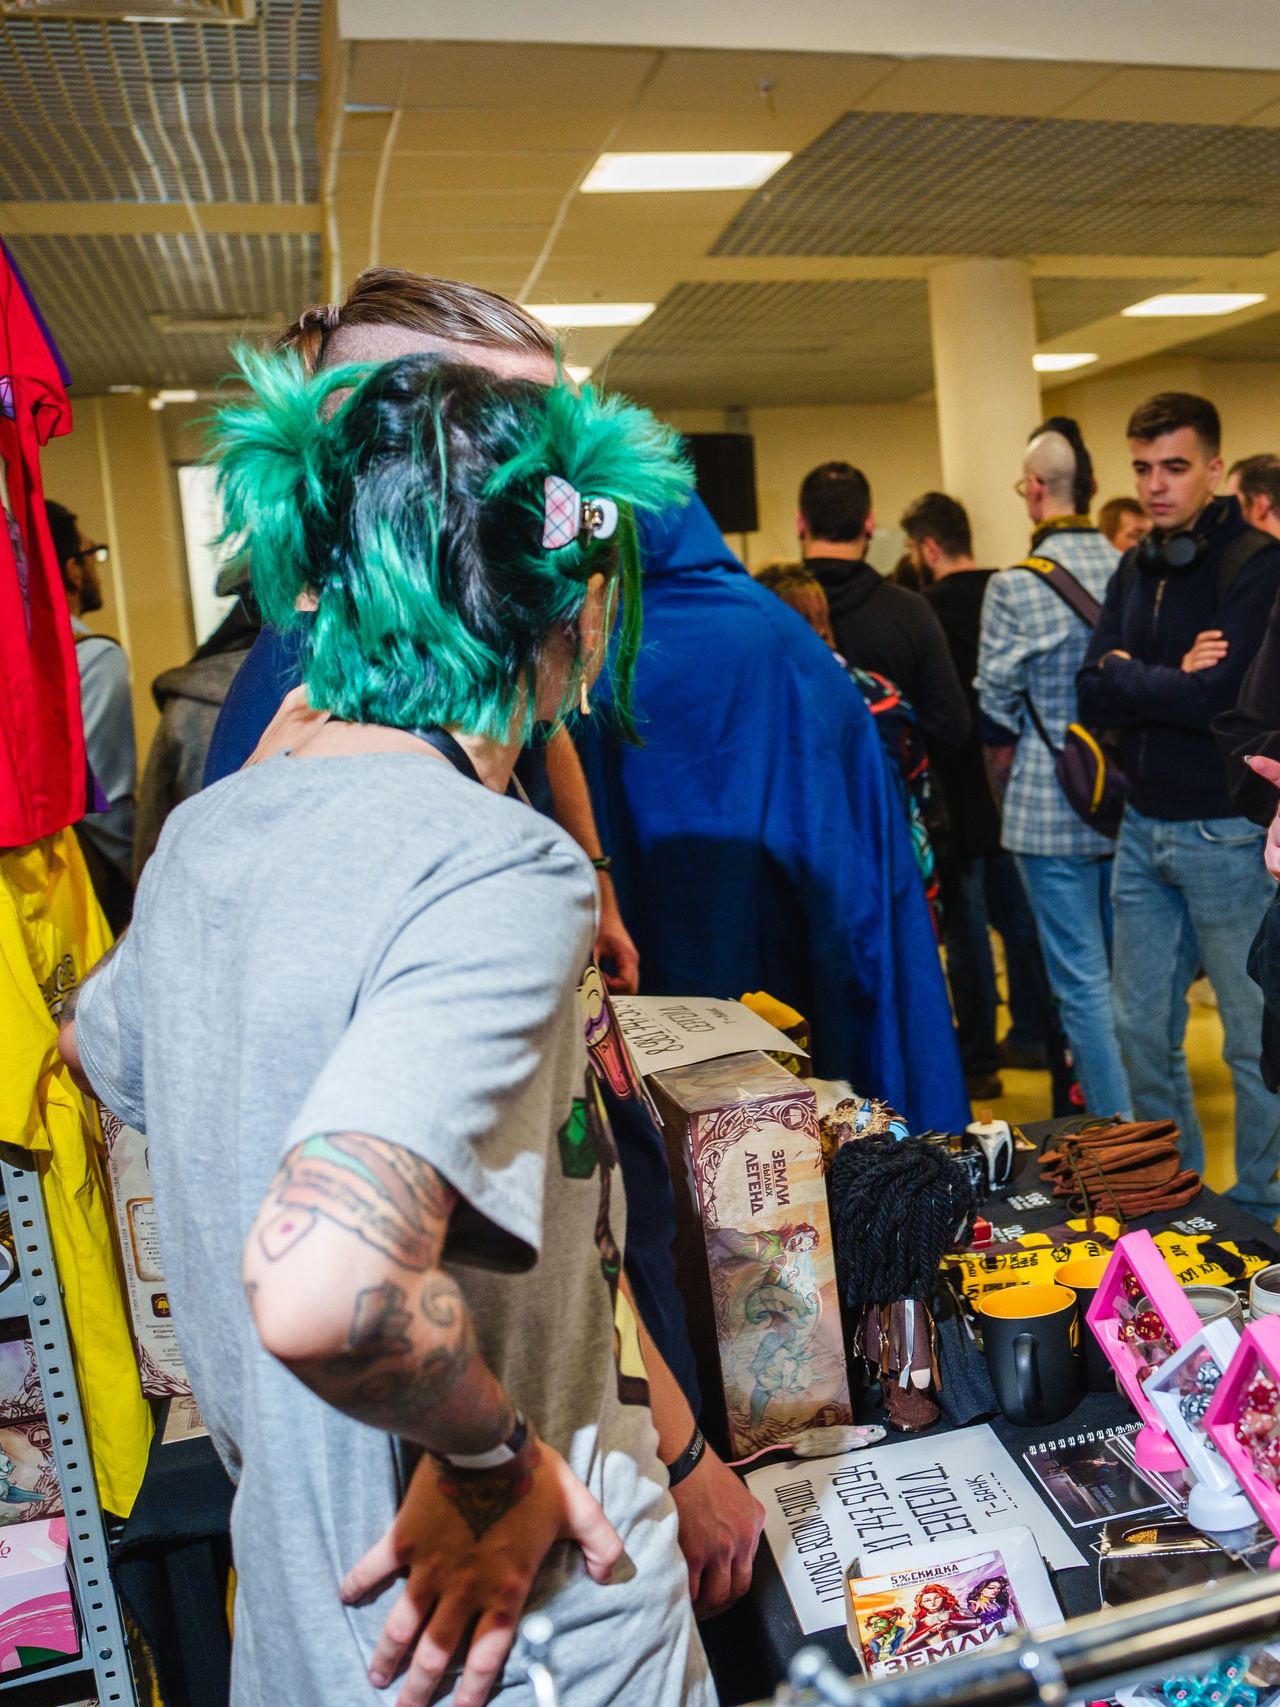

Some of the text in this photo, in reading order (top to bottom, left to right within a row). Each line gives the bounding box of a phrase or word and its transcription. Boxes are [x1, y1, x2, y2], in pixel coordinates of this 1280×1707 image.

[744, 1150, 764, 1217] ЛЕГЕНД
[762, 1163, 773, 1197] БЫЛЫХ
[772, 1149, 790, 1206] ЗЕМЛИ
[828, 1461, 878, 1487] 94
[775, 1480, 820, 1517] STUDIO
[837, 1482, 889, 1507] 50
[897, 1482, 978, 1543] ЕРГЕЙ
[966, 1474, 1008, 1518] Т-БАНК
[788, 1514, 833, 1554] ROOM
[849, 1506, 903, 1538] 747
[884, 1621, 1006, 1677] ЗЕМЛИ
